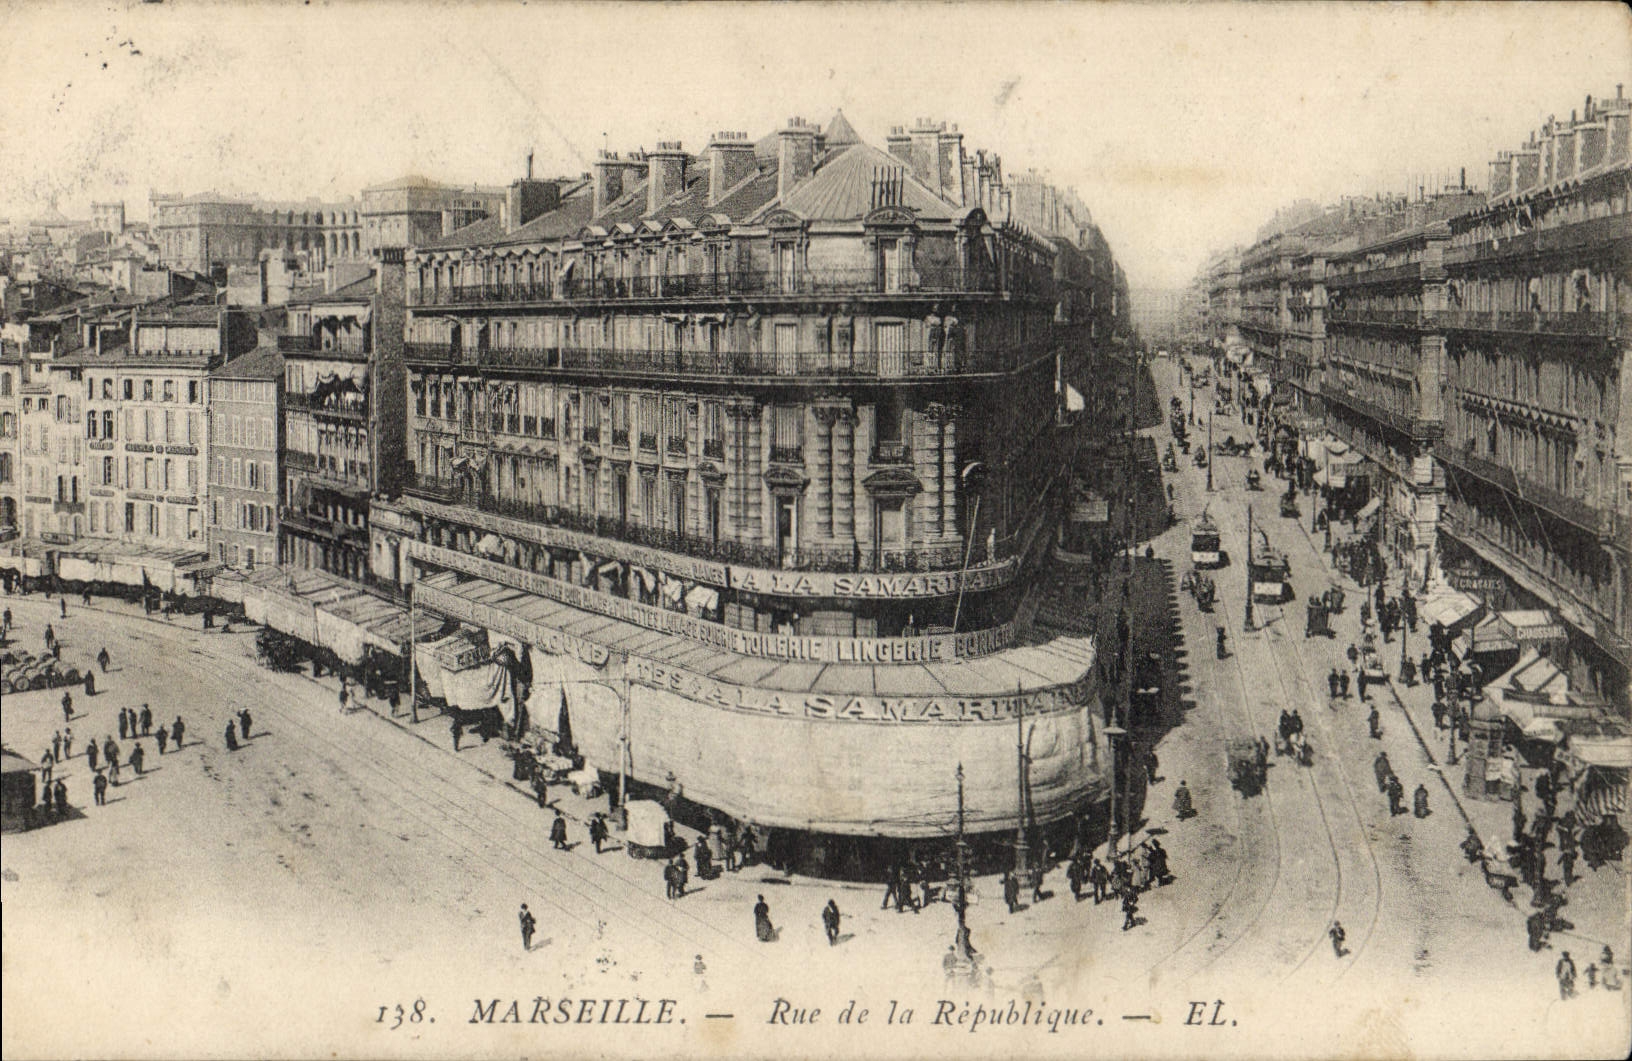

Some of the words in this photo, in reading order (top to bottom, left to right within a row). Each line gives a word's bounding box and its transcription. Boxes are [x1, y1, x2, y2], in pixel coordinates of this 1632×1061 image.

[741, 572, 762, 592] A
[771, 573, 820, 596] LA
[742, 629, 822, 661] TOILERIE
[837, 637, 943, 662] LINGERIE
